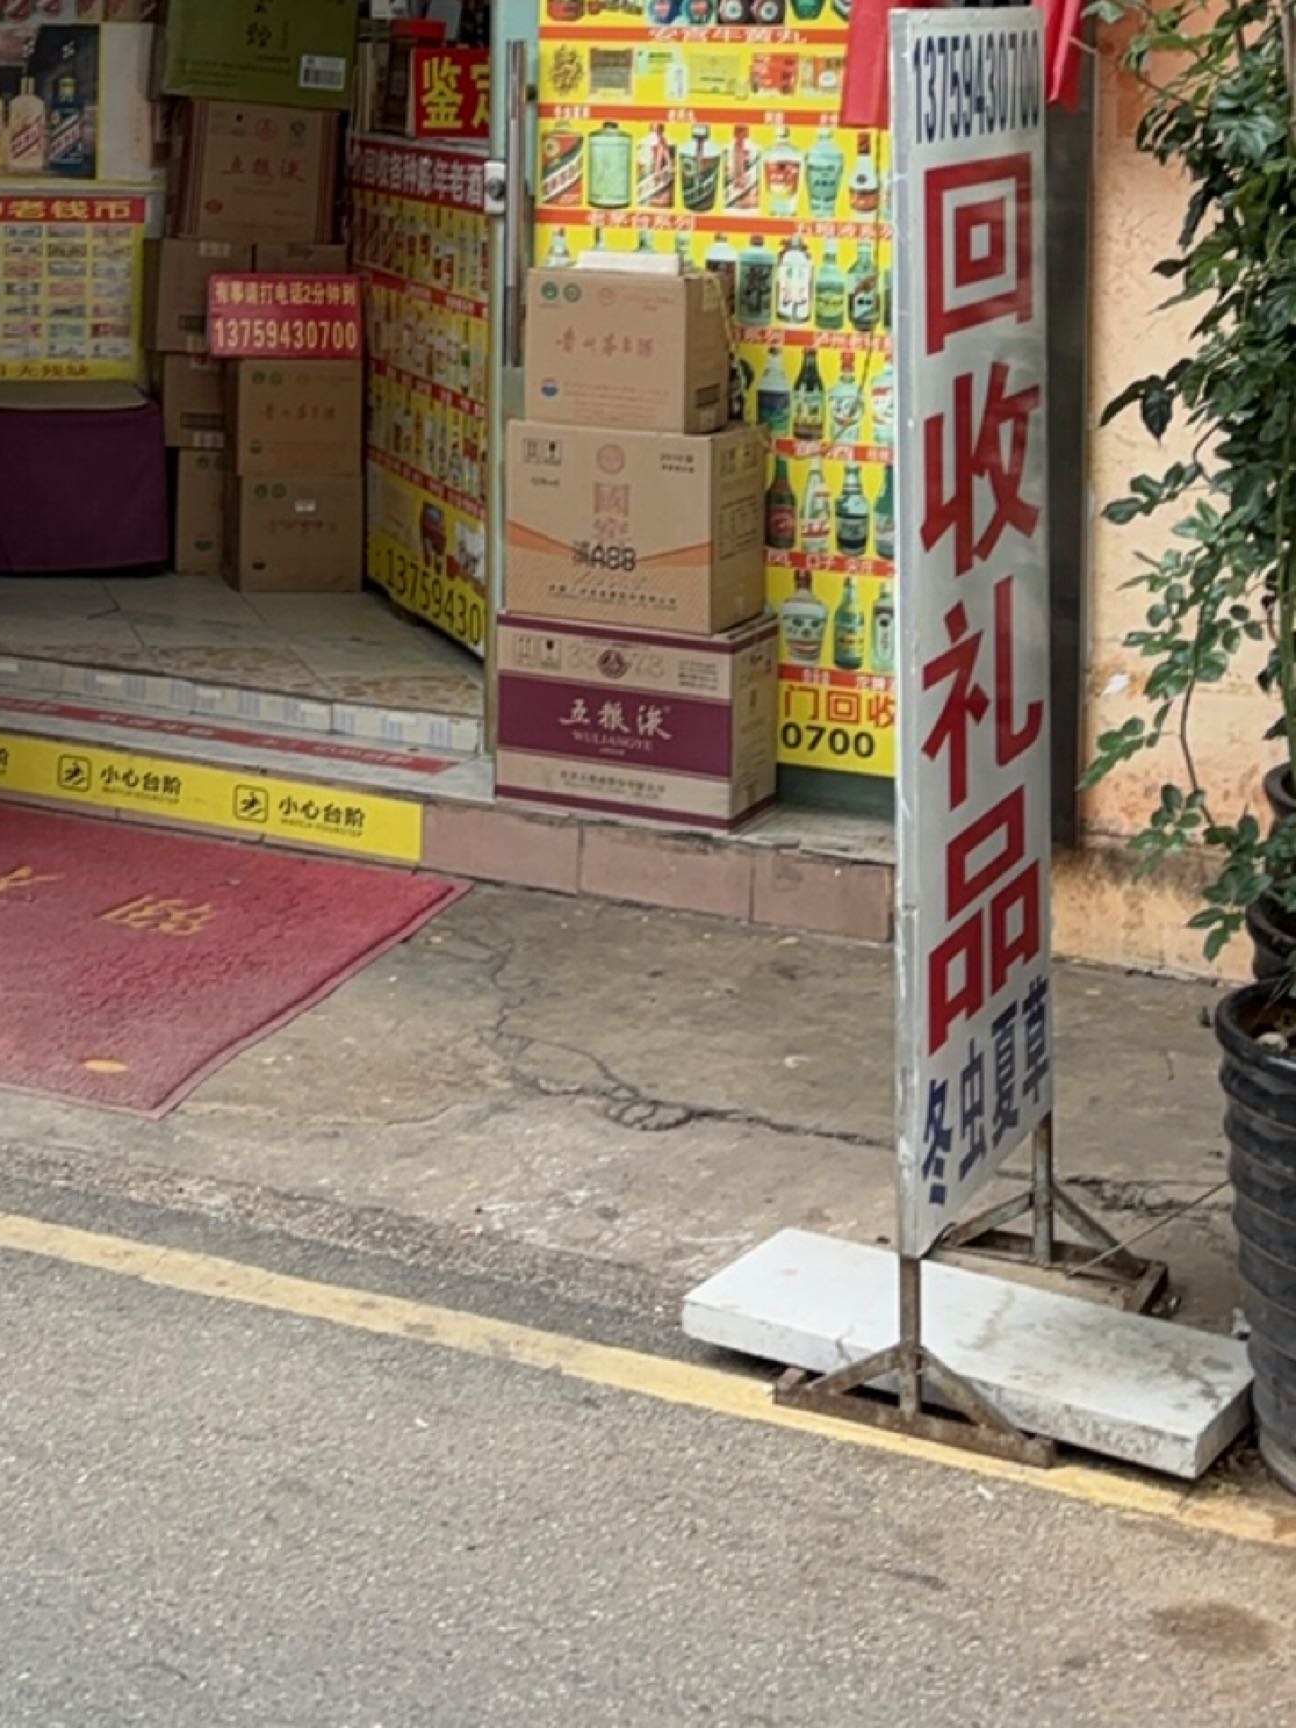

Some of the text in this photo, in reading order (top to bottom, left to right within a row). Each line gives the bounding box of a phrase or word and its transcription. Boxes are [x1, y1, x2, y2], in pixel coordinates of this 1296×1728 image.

[912, 31, 1039, 145] 13759430700
[214, 319, 358, 351] 13759430700
[919, 151, 1044, 1058] 回收礼品
[781, 721, 875, 759] 0700
[100, 764, 182, 795] 小心台阶
[278, 795, 366, 828] 小心台阶
[921, 974, 1051, 1207] 冬虫夏草
